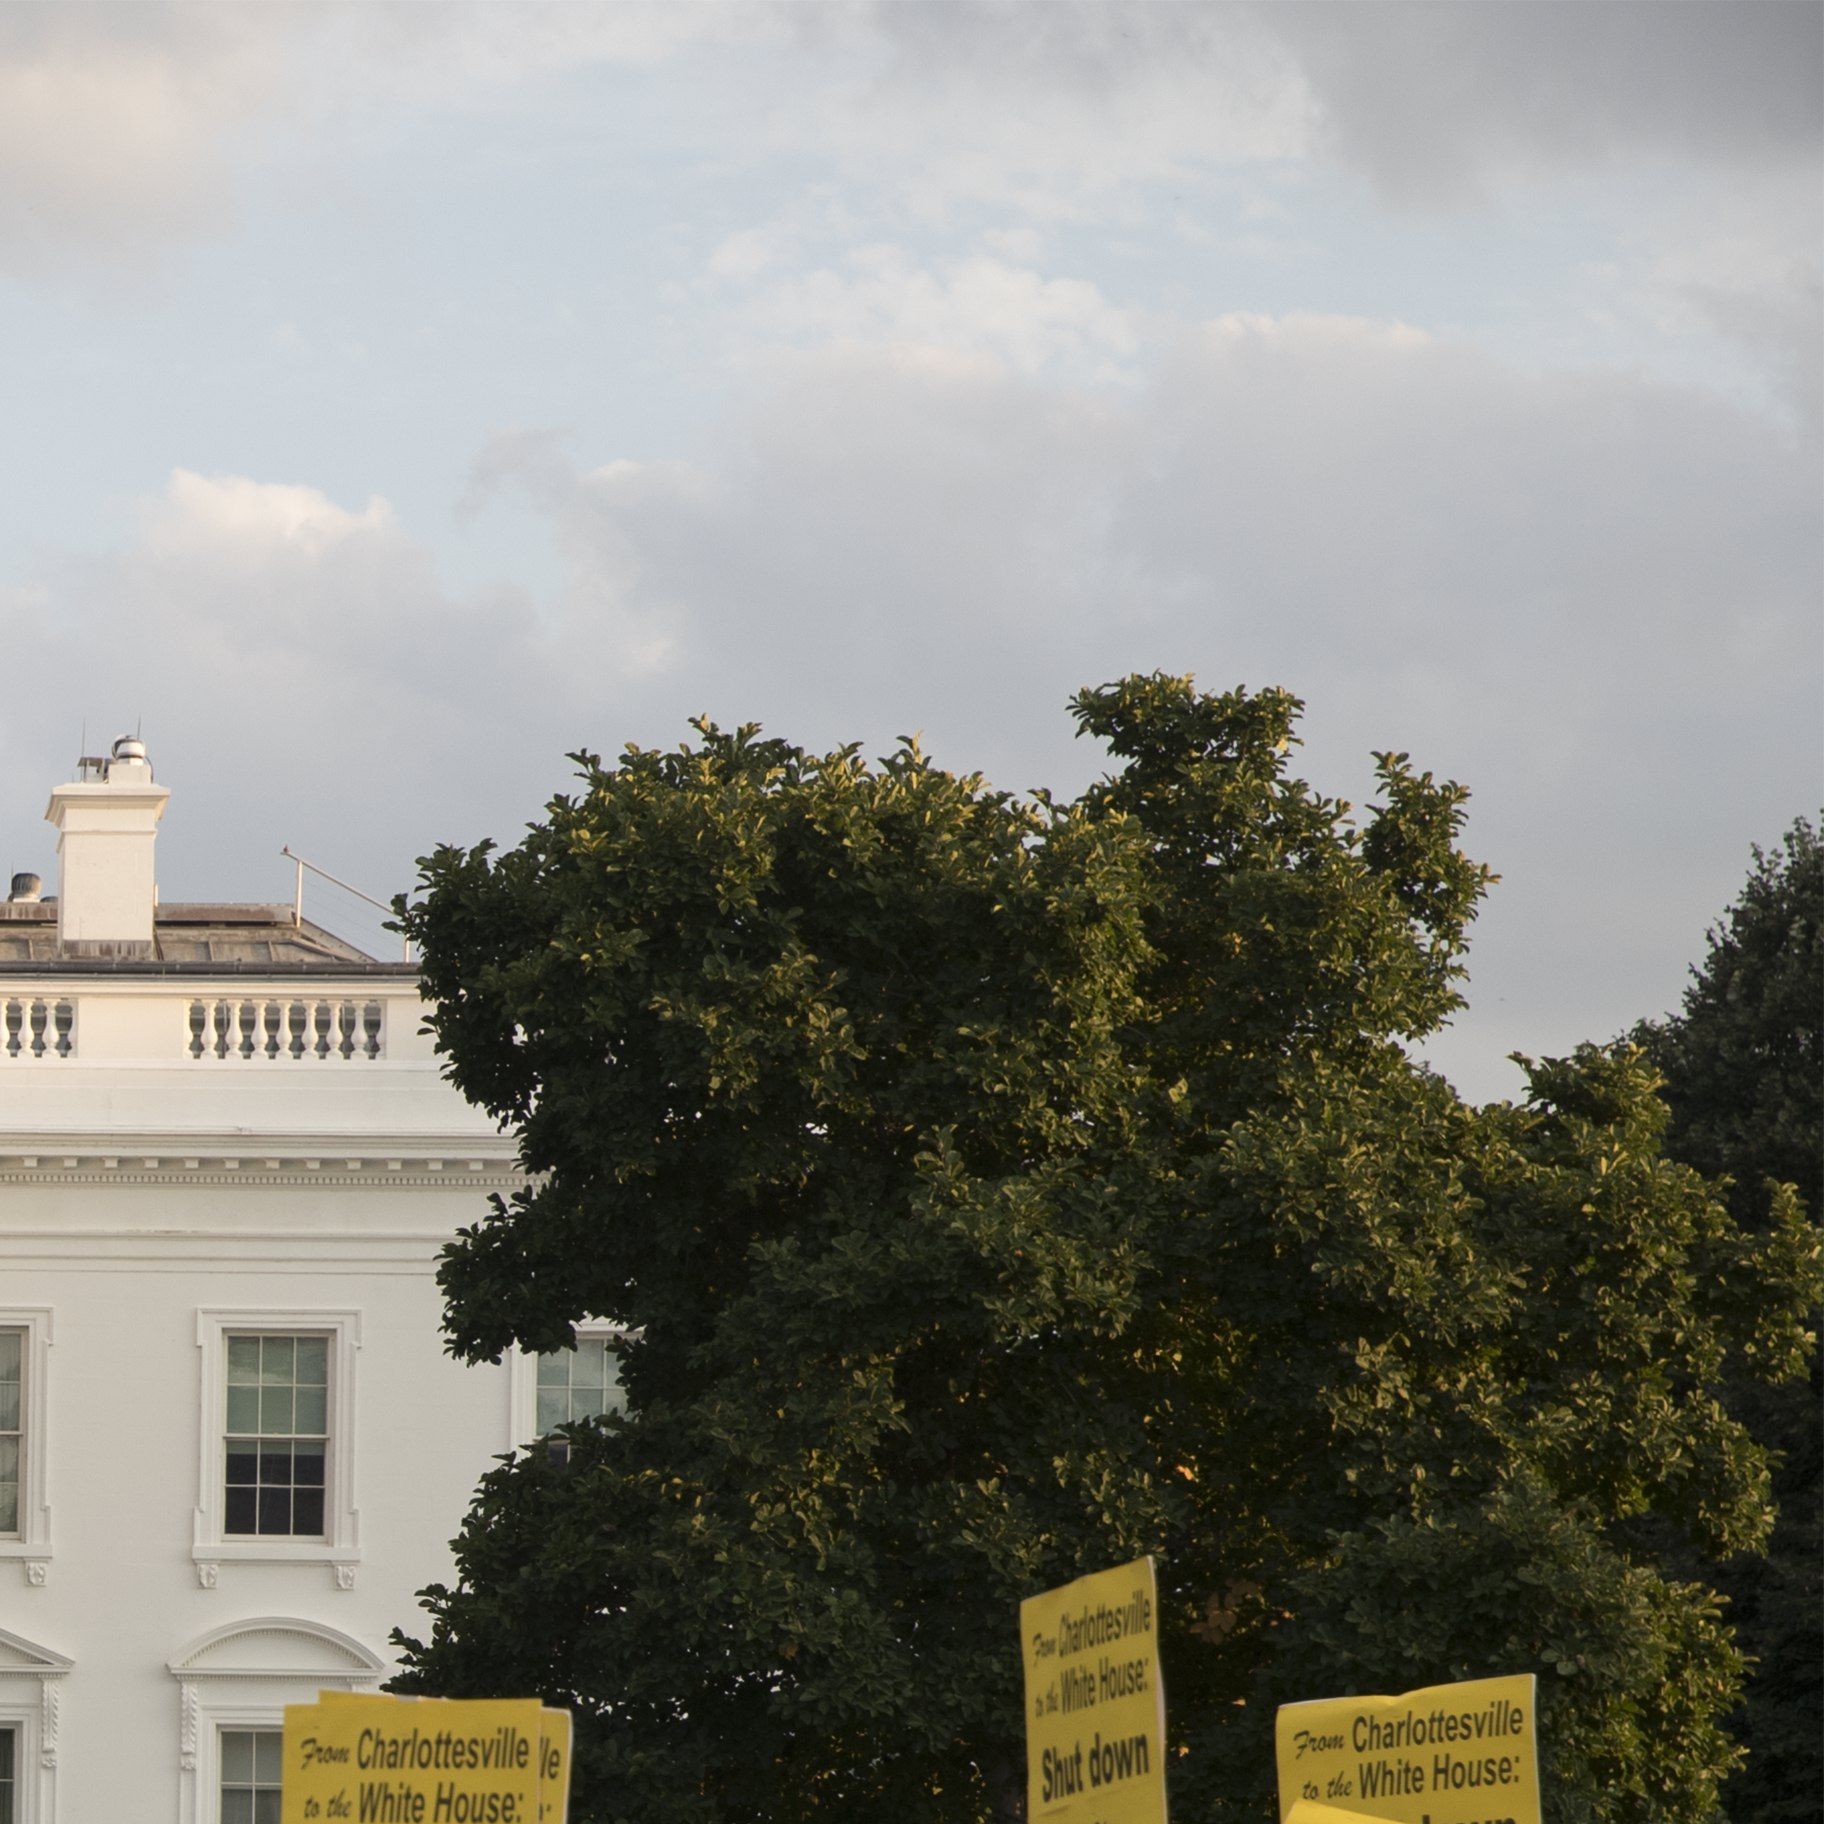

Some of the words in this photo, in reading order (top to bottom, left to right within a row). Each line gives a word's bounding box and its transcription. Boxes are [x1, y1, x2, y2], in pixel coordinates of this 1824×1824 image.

[1033, 1632, 1056, 1667] From
[1058, 1593, 1151, 1657] Charlottesville
[1035, 1697, 1044, 1719] to
[1045, 1690, 1059, 1716] the
[1060, 1668, 1097, 1717] White
[1099, 1656, 1149, 1702] House:
[300, 1737, 351, 1771] From
[356, 1727, 529, 1770] Charlottesville
[1293, 1730, 1345, 1760] From
[1352, 1700, 1524, 1753] Charlottesville
[1042, 1741, 1083, 1804] Shut
[1089, 1731, 1151, 1792] down
[1303, 1780, 1320, 1800] to
[1327, 1769, 1352, 1798] the
[1358, 1759, 1425, 1800] White
[1432, 1753, 1521, 1792] House:
[304, 1796, 321, 1819] to
[326, 1788, 352, 1819] the
[357, 1781, 425, 1824] White
[433, 1782, 524, 1824] House:
